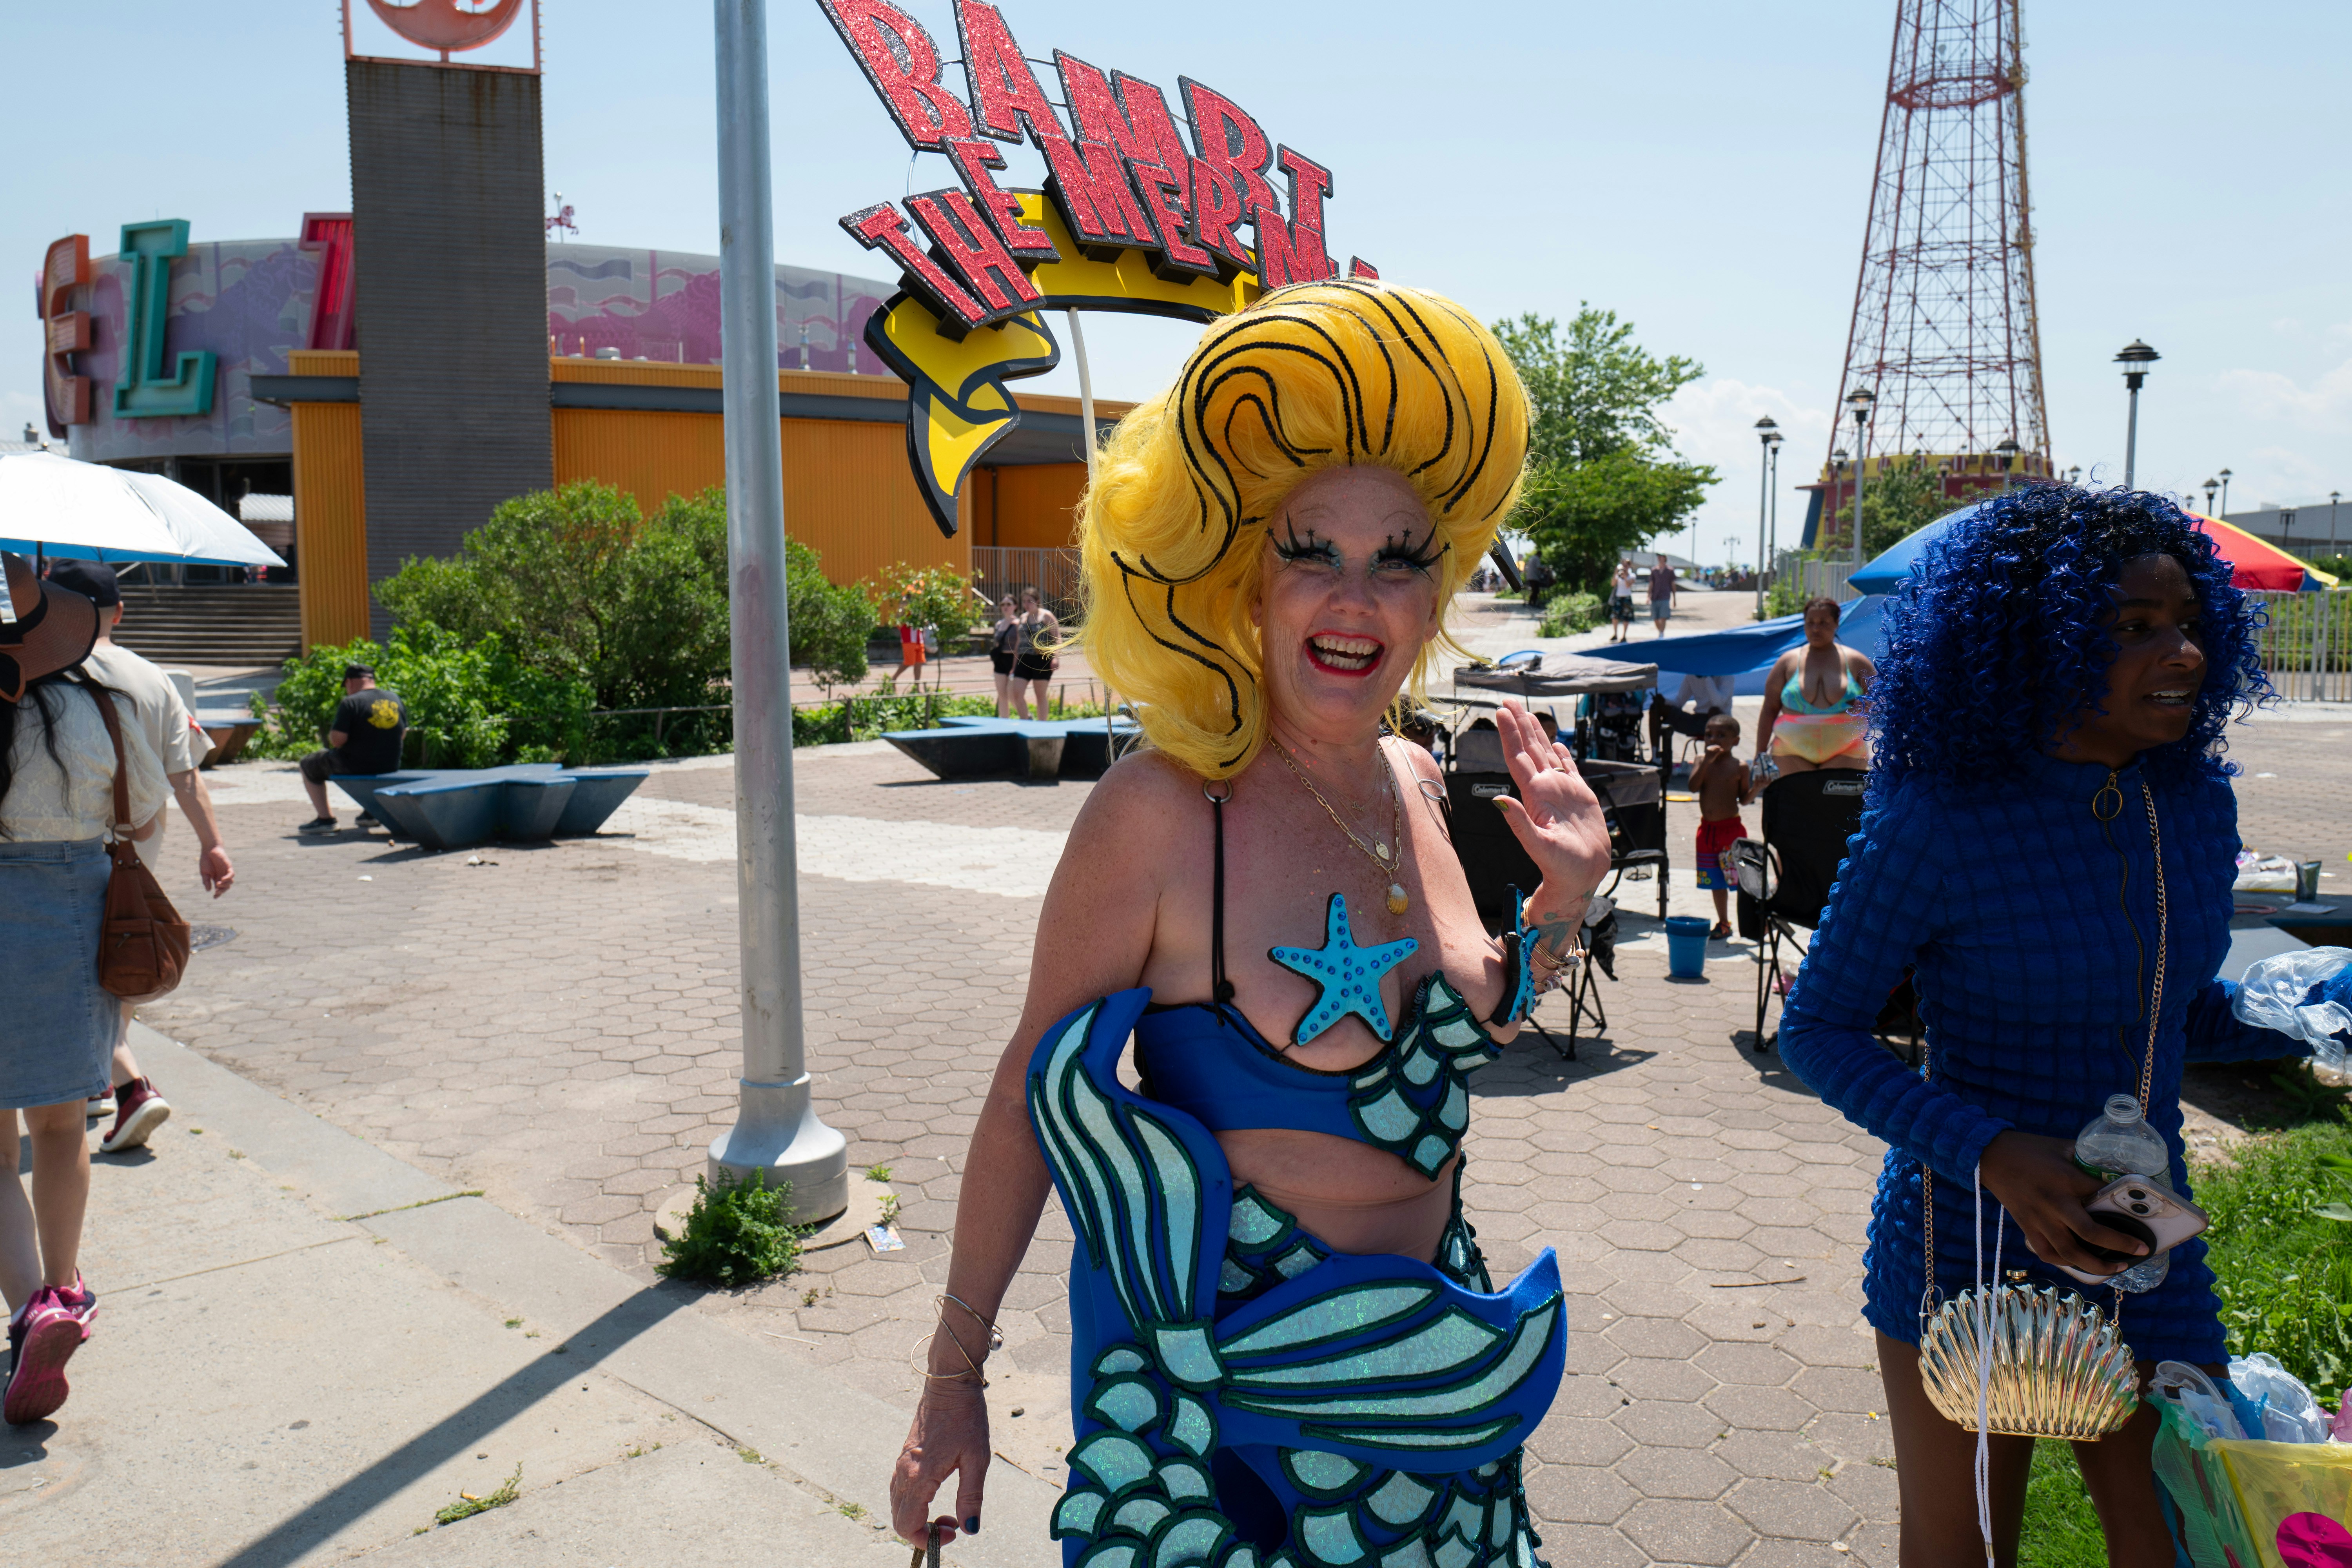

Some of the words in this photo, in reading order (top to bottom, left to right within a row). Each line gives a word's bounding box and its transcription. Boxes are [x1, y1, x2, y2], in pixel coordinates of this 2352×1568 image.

[839, 136, 1062, 328] THE
[1474, 785, 1501, 794] Coleman
[1827, 782, 1857, 791] Coleman
